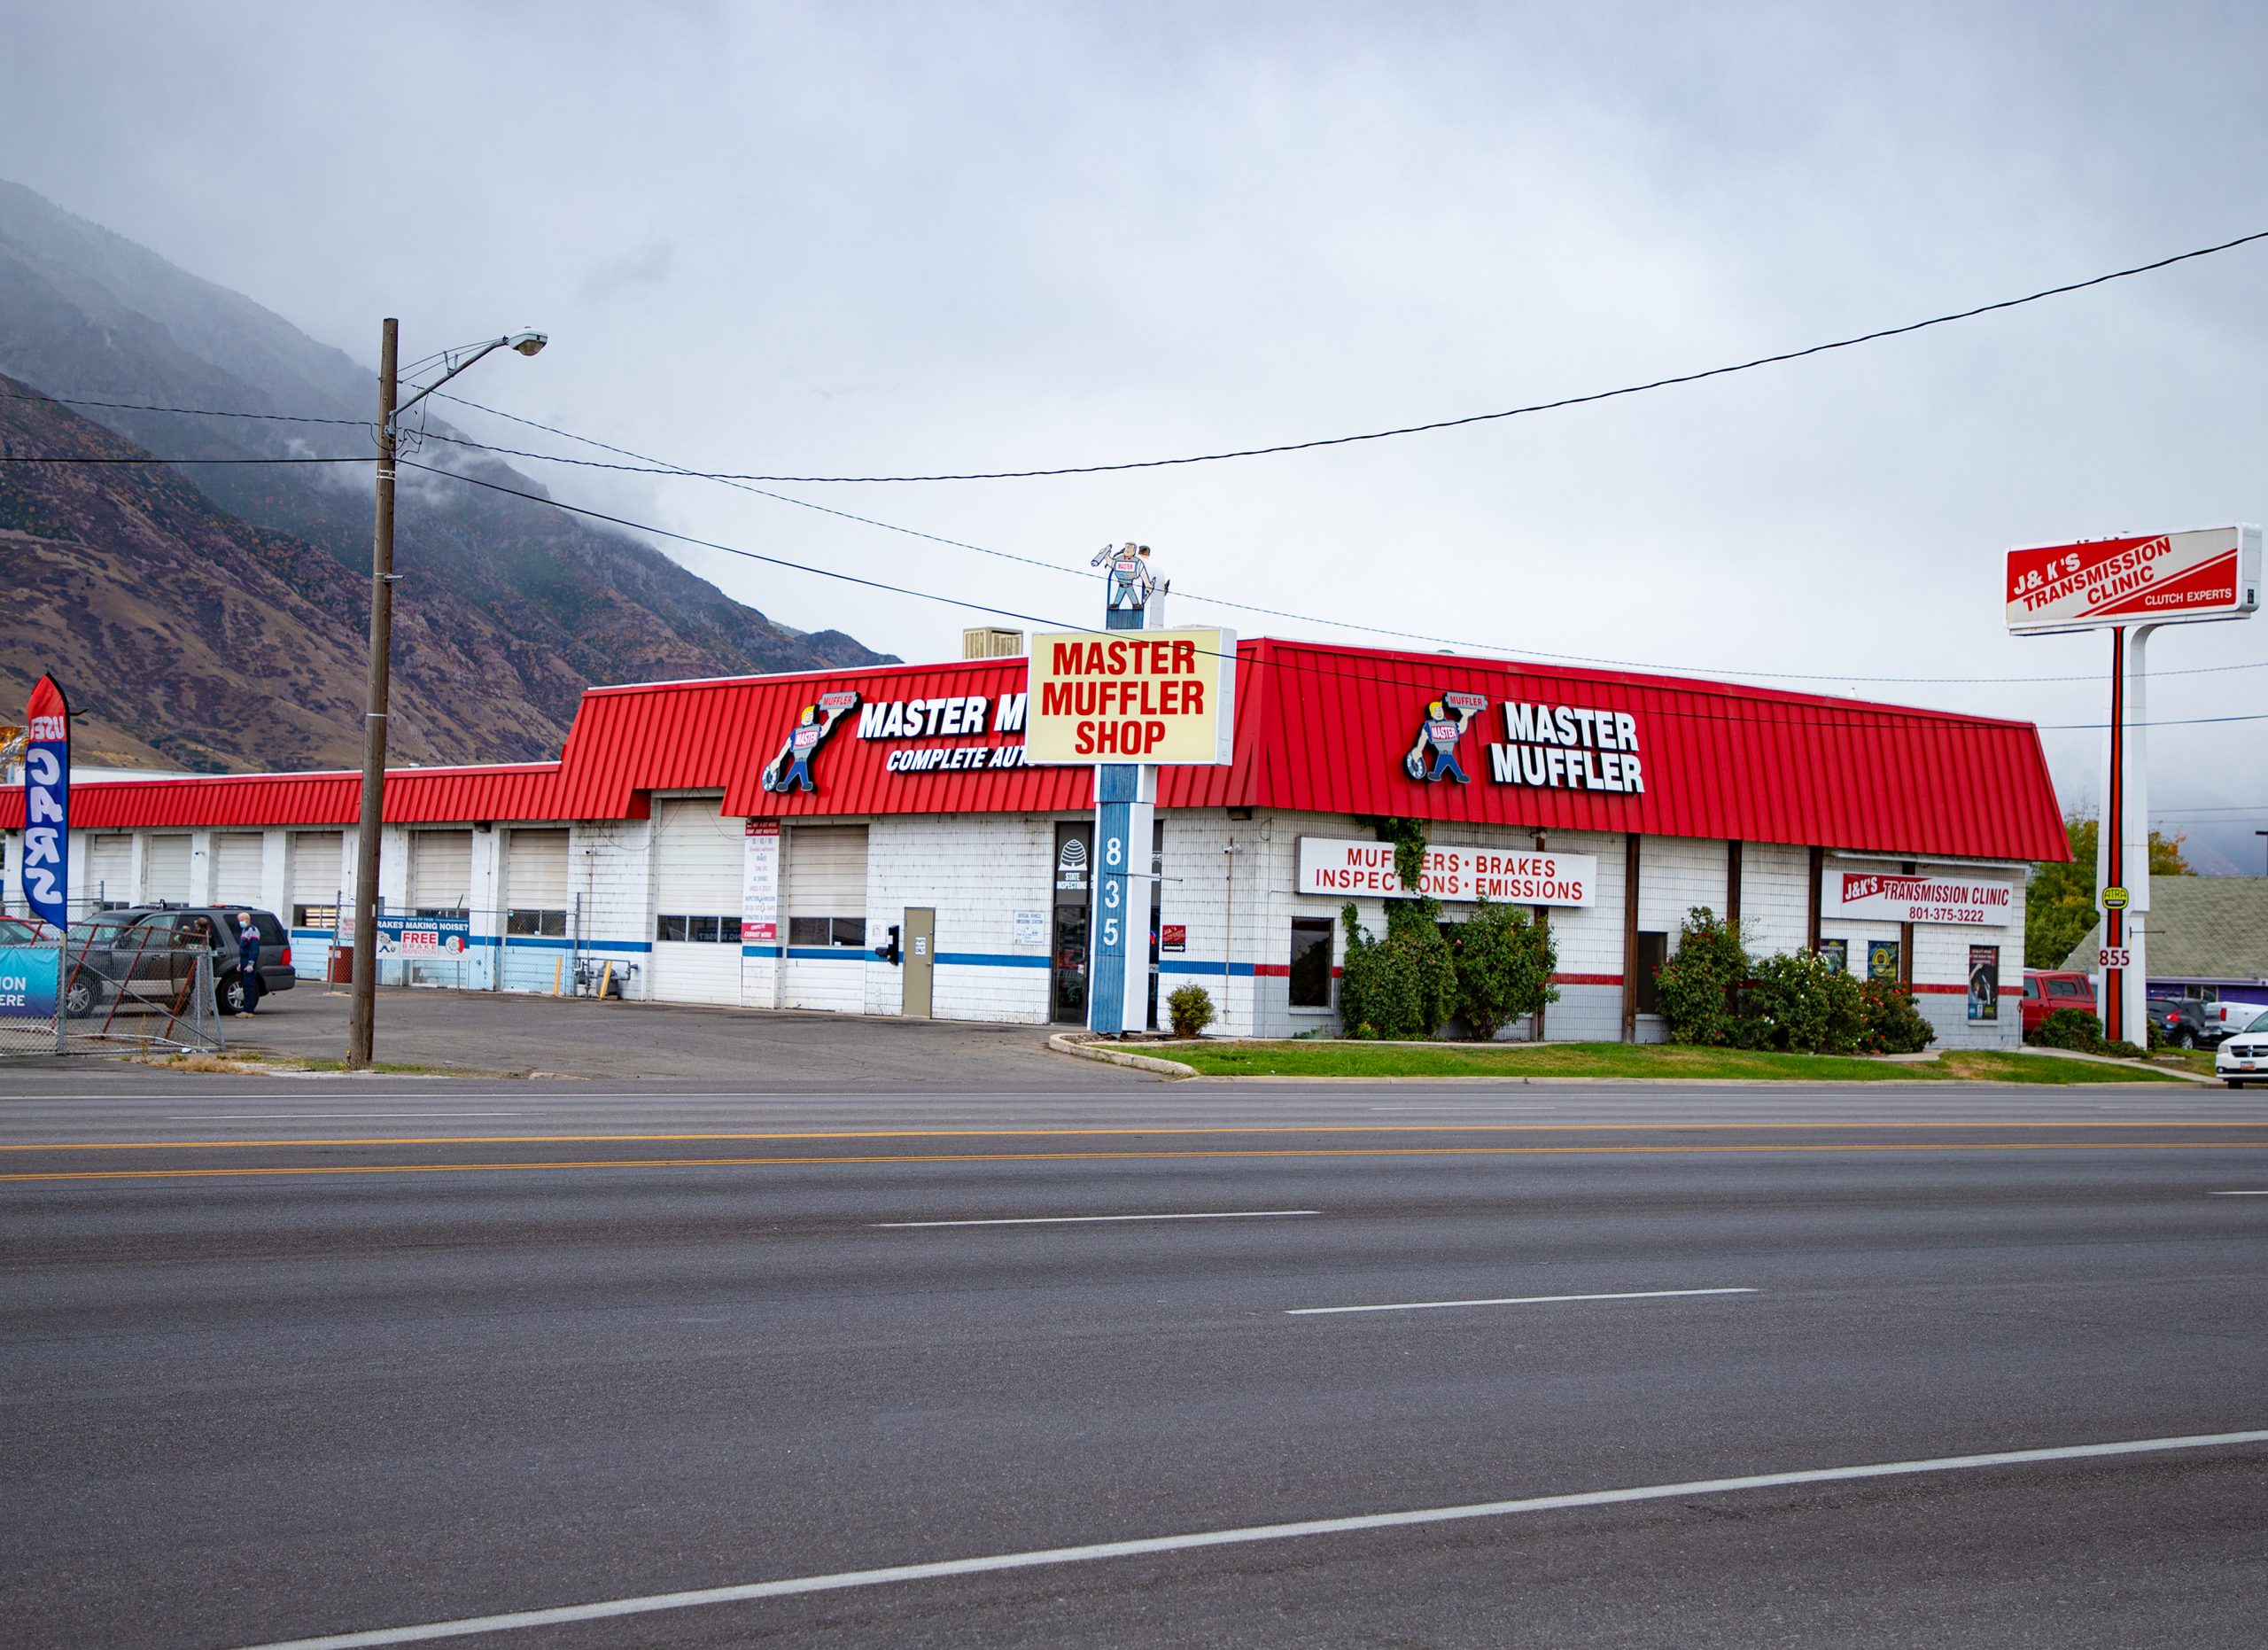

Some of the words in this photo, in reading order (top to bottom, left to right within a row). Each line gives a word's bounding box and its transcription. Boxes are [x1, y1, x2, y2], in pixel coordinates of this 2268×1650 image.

[2023, 535, 2171, 612] TRANSMISSION
[2086, 565, 2155, 604] CLINIC
[2145, 592, 2183, 606] CLUTCH
[2186, 588, 2233, 602] EXPERTS
[1052, 641, 1195, 675] MASTER
[823, 696, 853, 706] MUFFLER
[1042, 681, 1204, 716] MUFFLER
[1449, 695, 1483, 707] MUFFLER
[857, 697, 988, 738] MASTER
[1504, 701, 1640, 751] MASTER
[795, 731, 819, 747] MASTER
[1075, 720, 1166, 755] SHOP
[1430, 726, 1457, 739] MASTER
[886, 747, 989, 772] COMPLETE
[988, 745, 1035, 767] AUT
[1491, 743, 1645, 793] MUFFLER
[1066, 872, 1080, 881] STATE
[1347, 848, 1460, 873] MUFERS
[1476, 855, 1557, 878] BRAKES
[1056, 881, 1087, 890] INSPECTIONS
[1316, 868, 1459, 895] INSPECONS
[1475, 877, 1583, 901] EMISSIONS
[1845, 876, 1878, 900] J&K'S
[1883, 880, 1969, 904] TRANSMISSION
[1972, 887, 2009, 907] CLINIC
[2104, 889, 2126, 899] ATRA
[1909, 907, 1984, 922] 801-375-3222
[403, 932, 437, 944] FREE
[2099, 950, 2130, 966] 855
